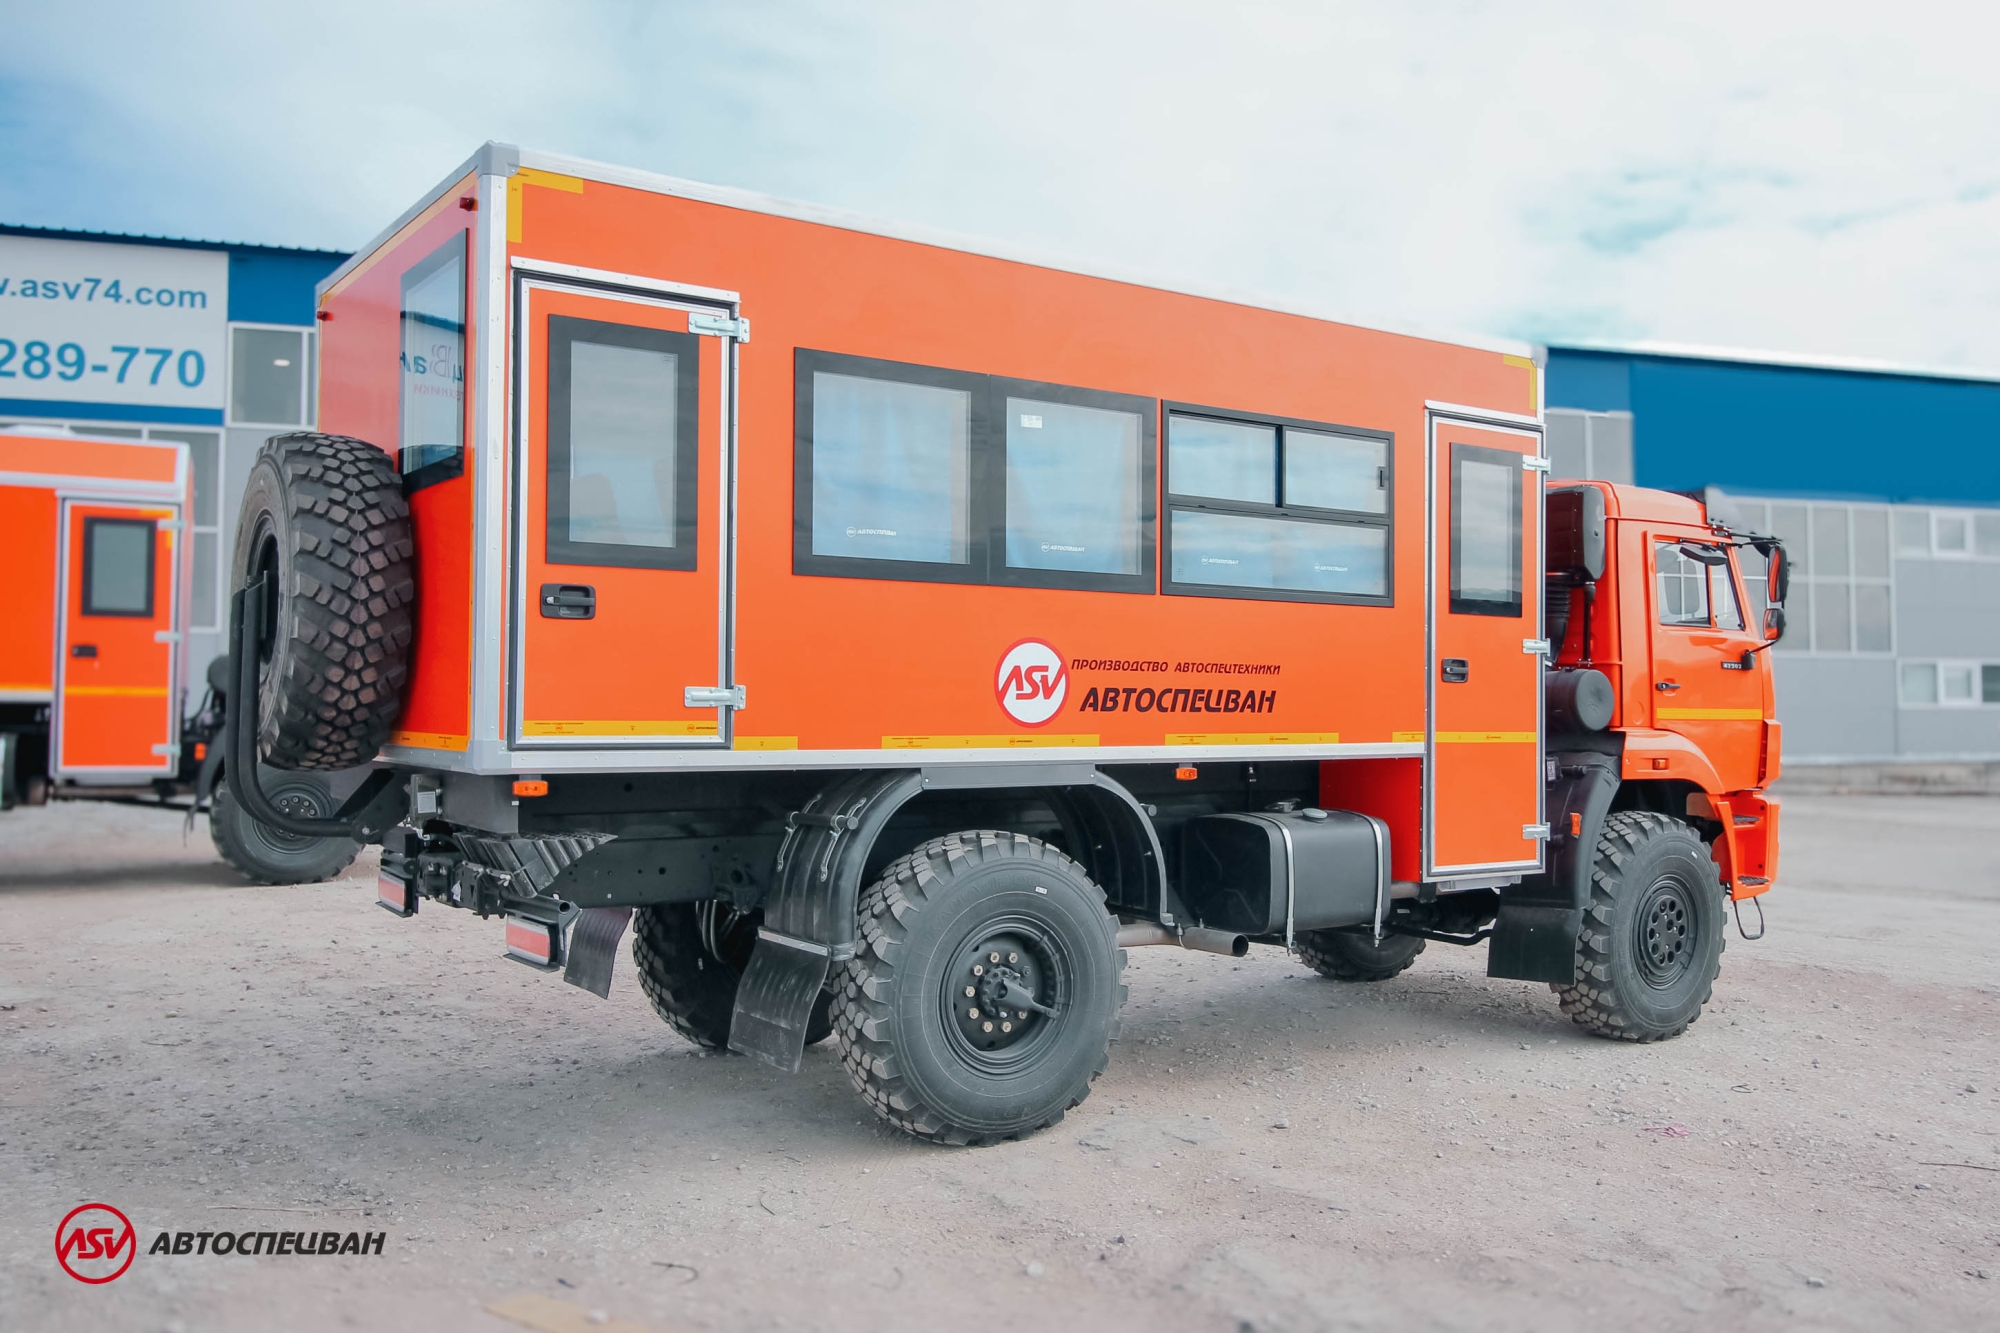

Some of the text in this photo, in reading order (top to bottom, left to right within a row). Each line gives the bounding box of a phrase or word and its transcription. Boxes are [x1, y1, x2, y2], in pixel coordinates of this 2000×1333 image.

[1071, 659, 1281, 676] ПРОИЗВОДСТВО АВТОСПЕЦТЕХНИКИ
[1079, 687, 1277, 713] АВТОСПЕЦВАН
